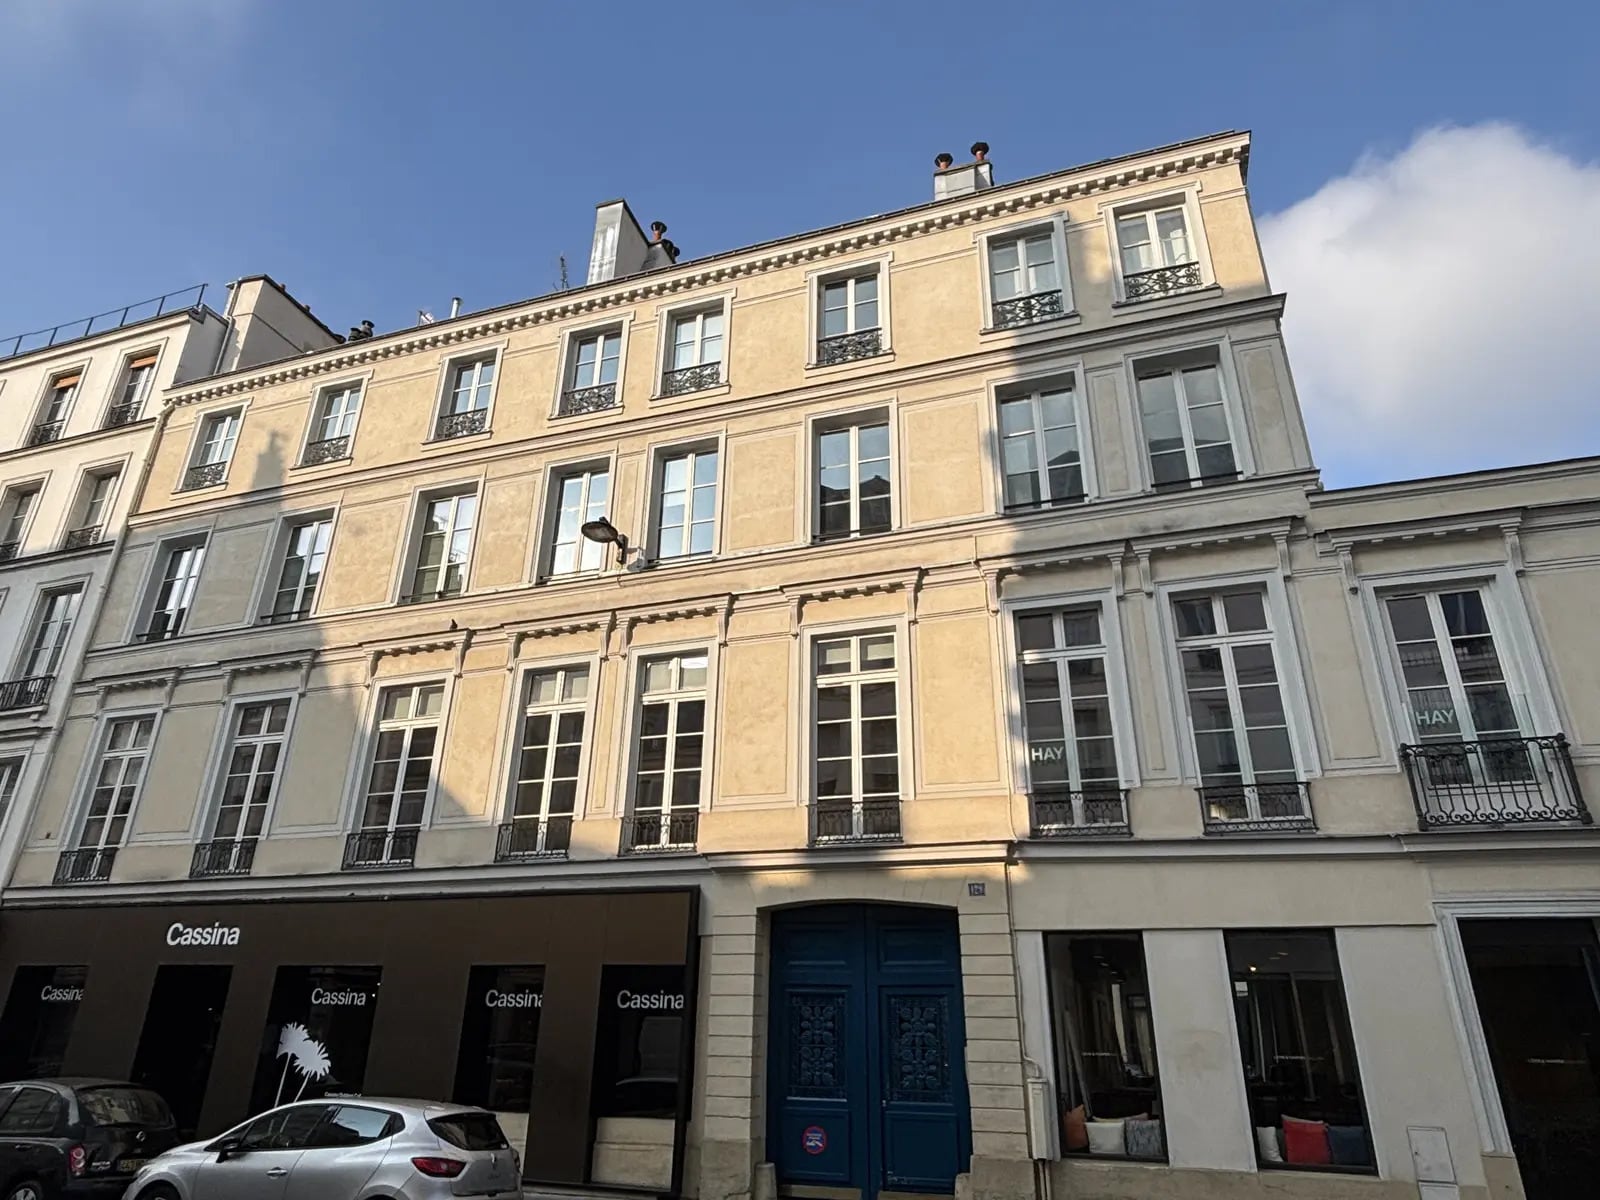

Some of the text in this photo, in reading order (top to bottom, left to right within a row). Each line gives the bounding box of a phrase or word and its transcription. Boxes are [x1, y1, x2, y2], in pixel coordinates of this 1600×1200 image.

[1415, 709, 1454, 725] HAY
[1031, 746, 1064, 761] HAY
[166, 922, 241, 946] Cassina
[311, 988, 366, 1006] Cassina
[616, 989, 685, 1009] Cassina
